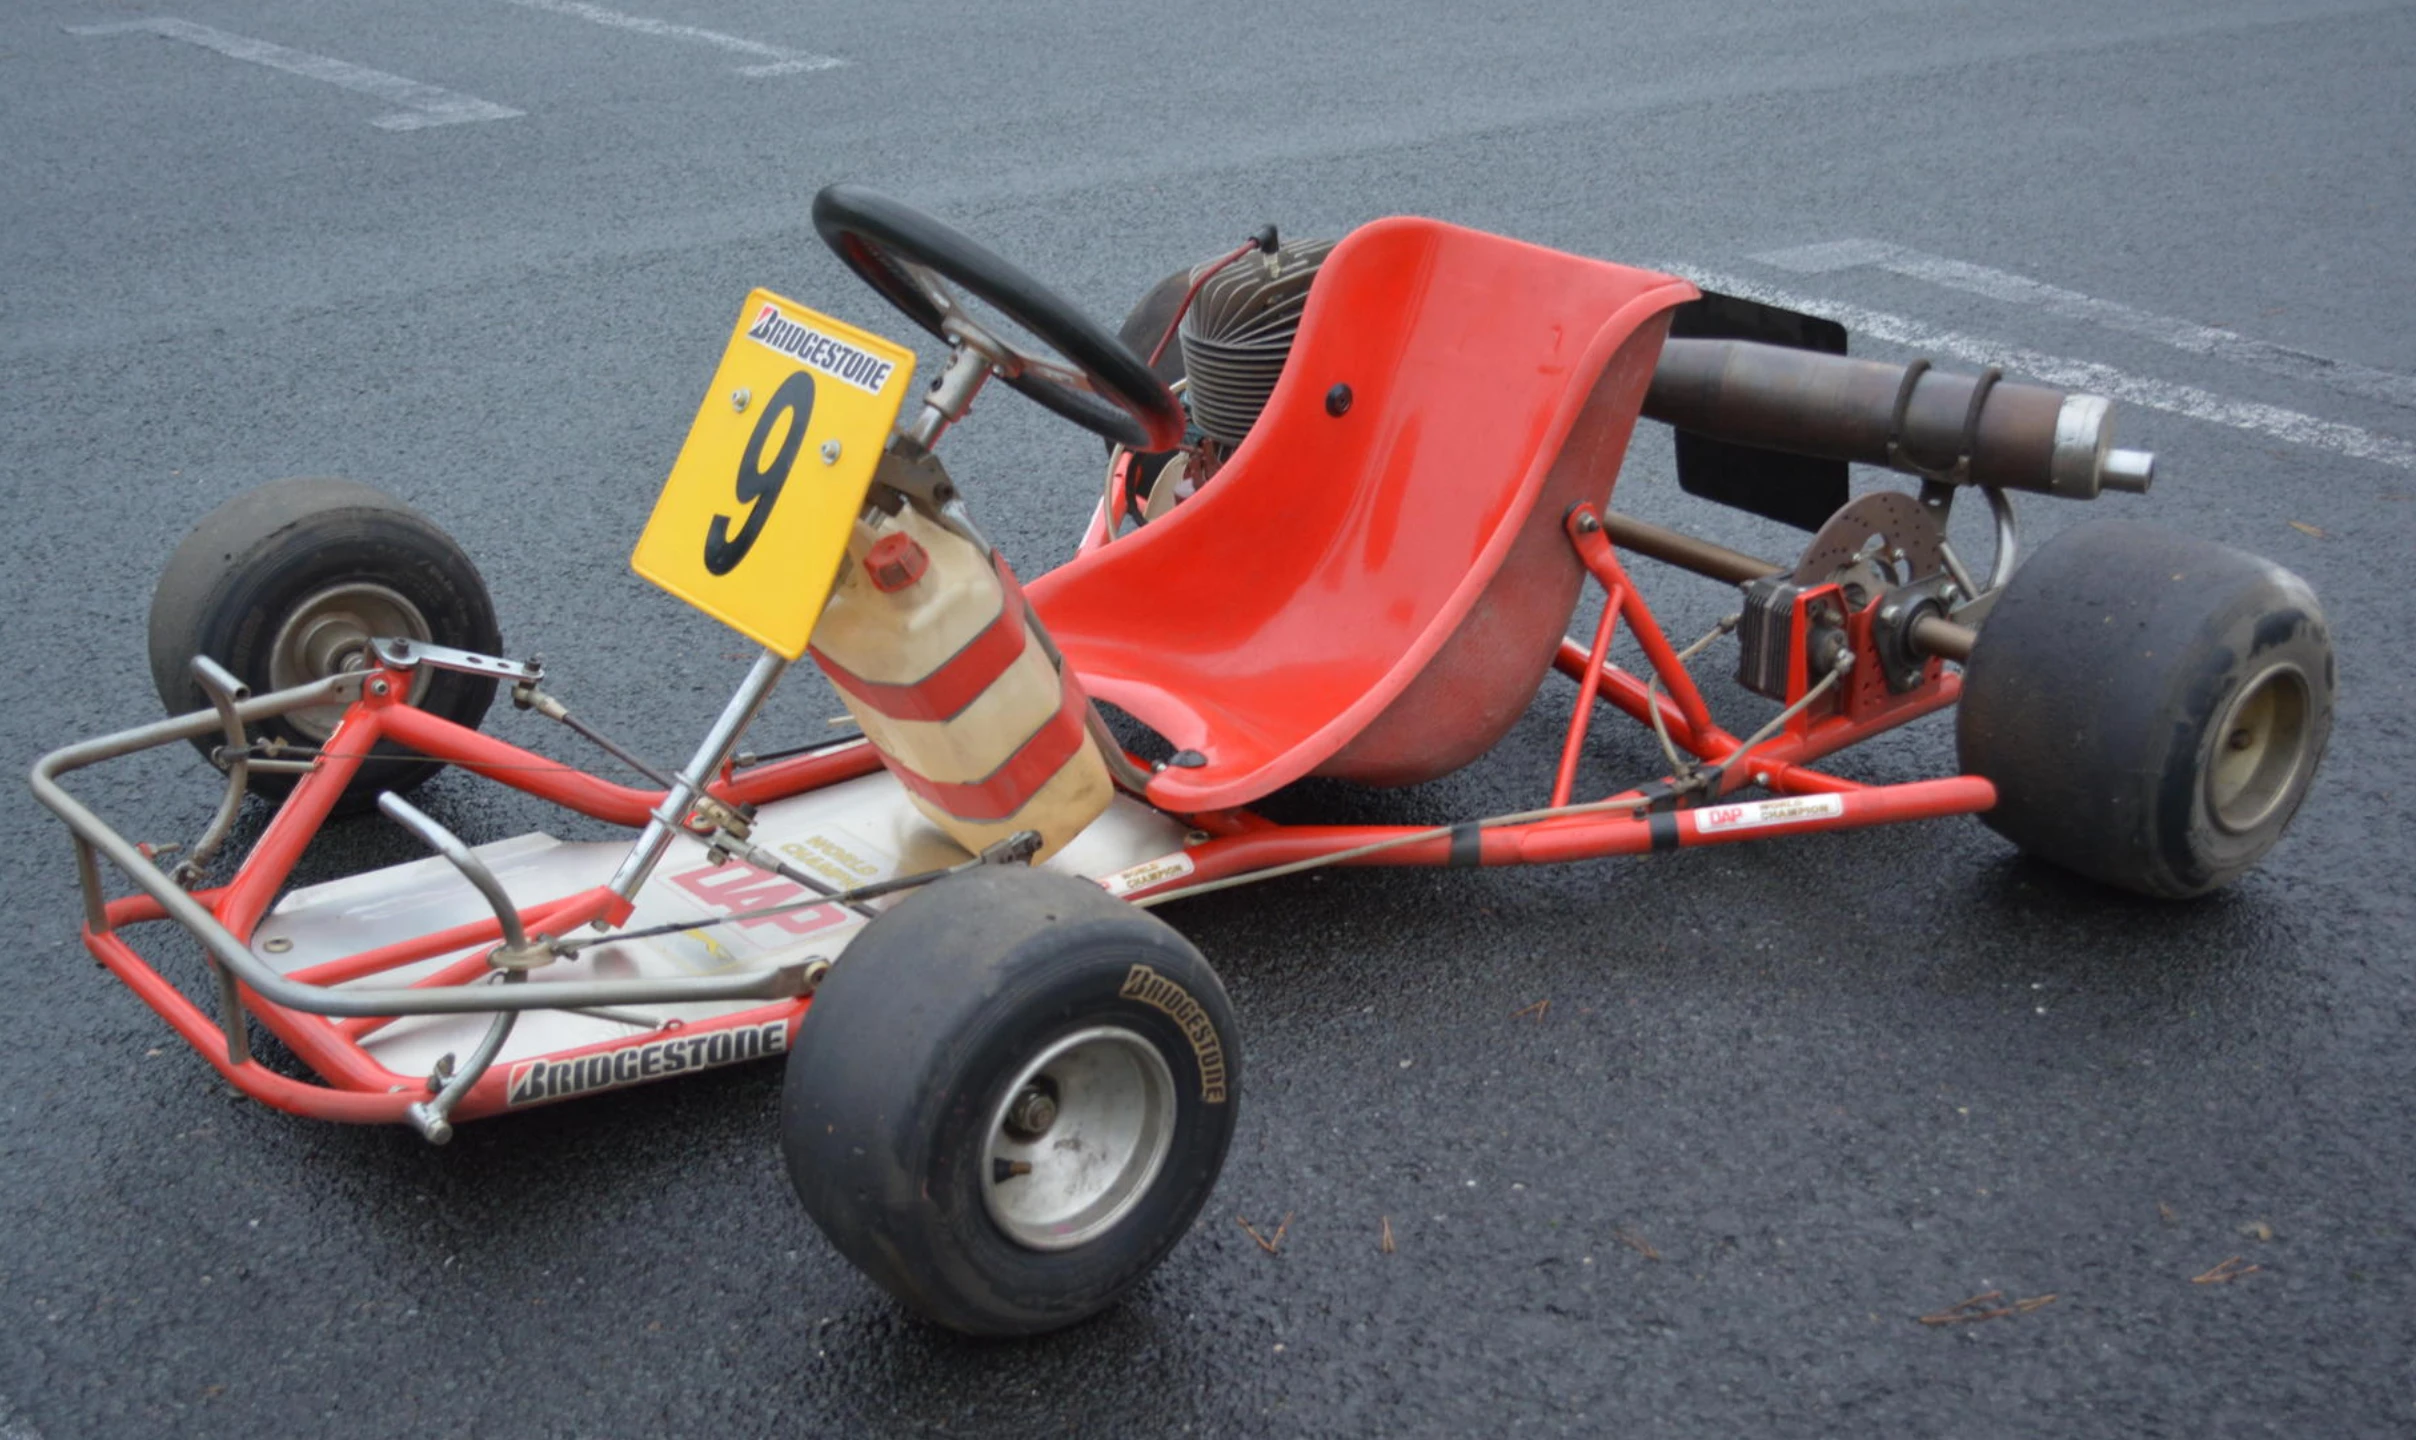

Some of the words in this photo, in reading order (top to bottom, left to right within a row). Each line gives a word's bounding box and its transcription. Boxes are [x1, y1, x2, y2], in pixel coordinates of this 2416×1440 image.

[748, 306, 892, 392] BRIDGESTONE
[704, 370, 816, 577] 9
[1709, 808, 1743, 825] DAP
[669, 858, 848, 935] DAP
[510, 1023, 785, 1105] BRIDGESTONE
[1119, 963, 1226, 1104] BRIDGESTONE
